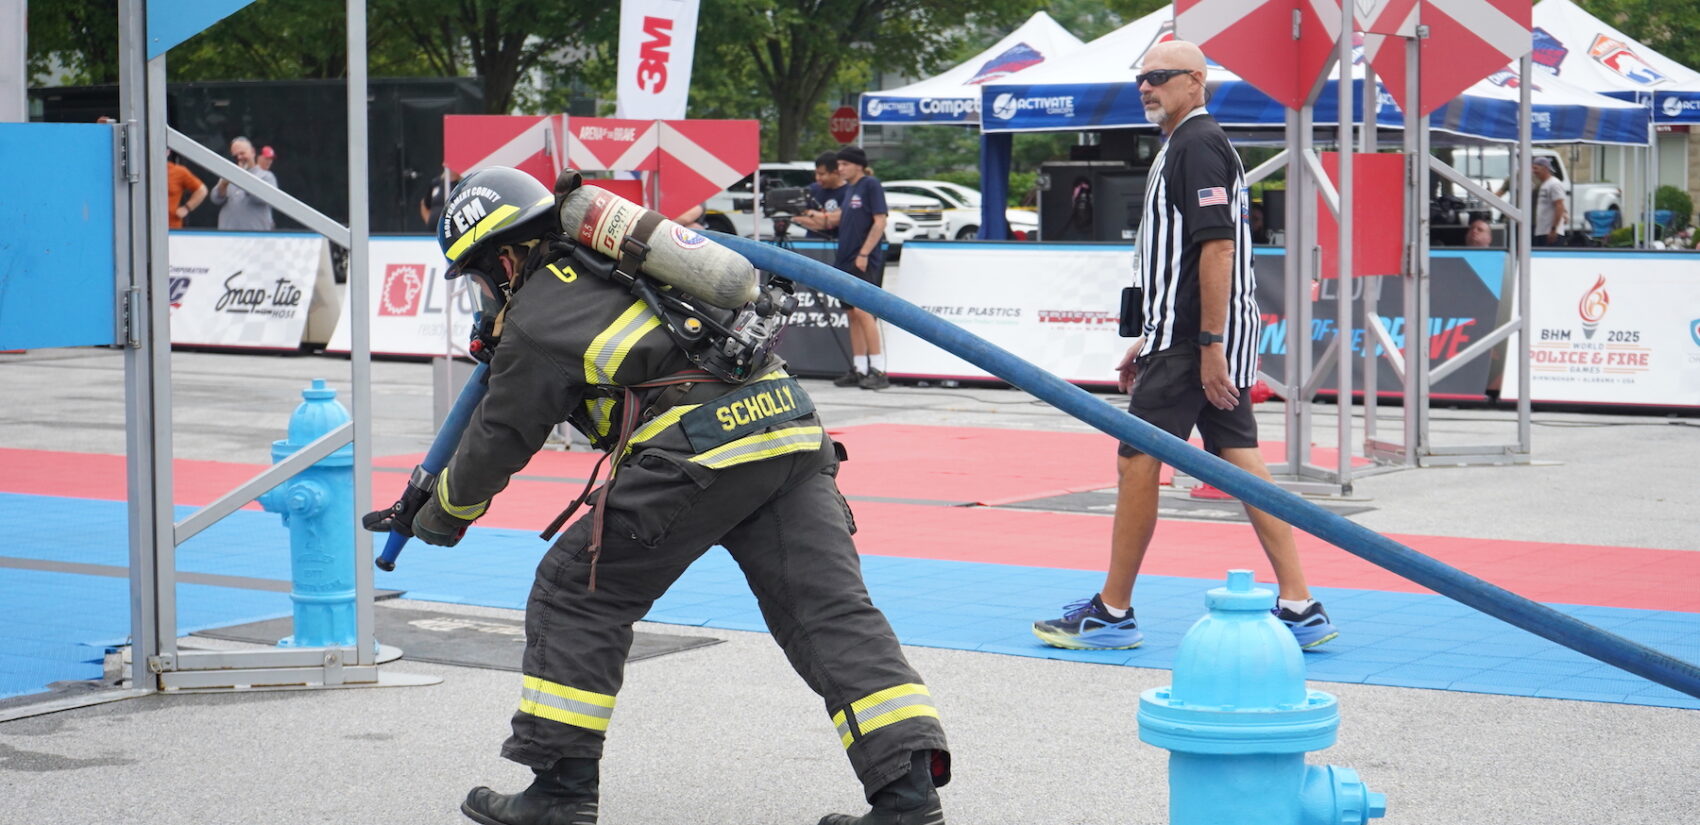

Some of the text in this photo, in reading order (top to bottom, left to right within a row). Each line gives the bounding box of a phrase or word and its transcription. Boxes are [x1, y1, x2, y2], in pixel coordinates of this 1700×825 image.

[637, 16, 673, 94] 3M
[1017, 96, 1074, 109] ACTIVATE
[831, 117, 858, 132] STOP
[471, 187, 501, 202] COUNTY
[453, 197, 486, 233] EM
[608, 206, 627, 235] SCOTT
[967, 306, 1022, 318] PLASTICS
[1541, 329, 1640, 343] BHM 2025
[1591, 352, 1603, 365] &
[1607, 352, 1649, 366] FIRE
[1569, 366, 1600, 374] GAMES
[716, 385, 796, 431] SCHOLLY
